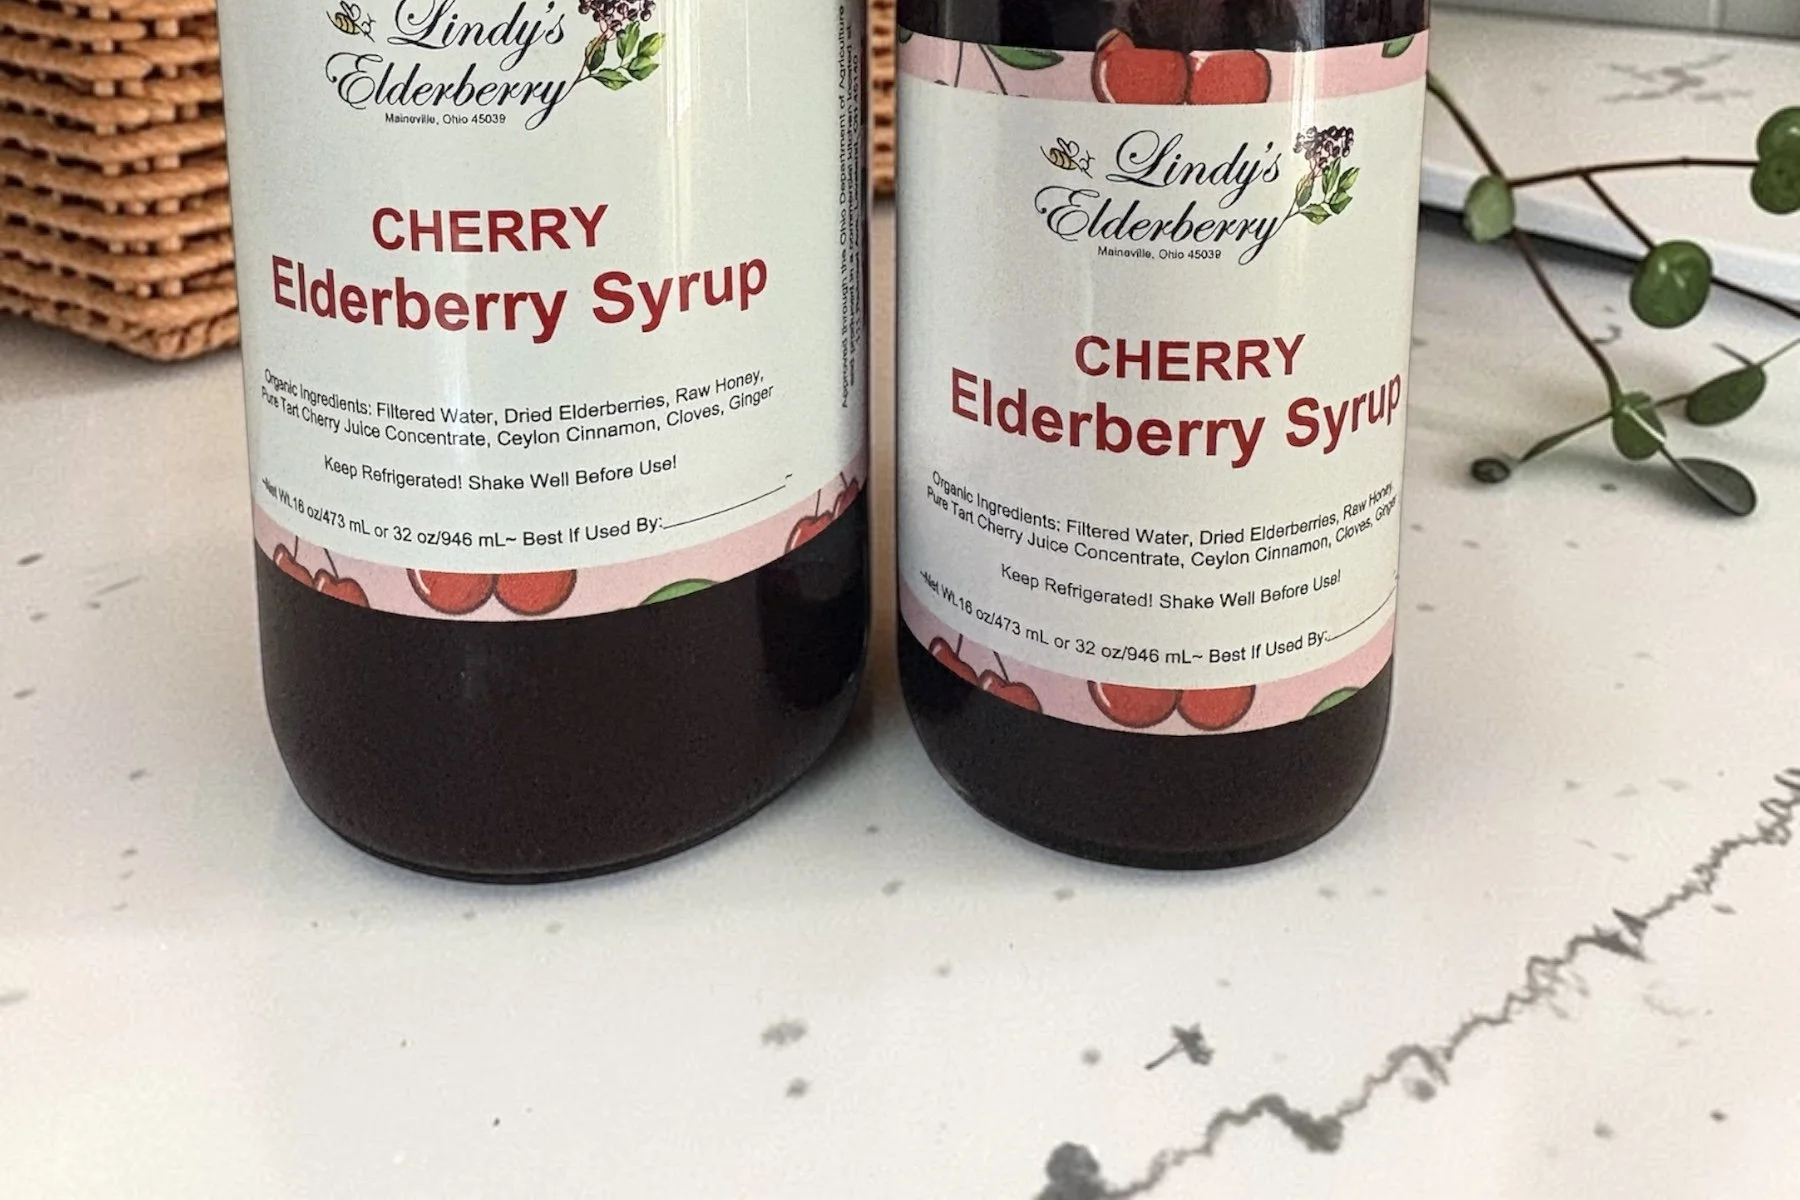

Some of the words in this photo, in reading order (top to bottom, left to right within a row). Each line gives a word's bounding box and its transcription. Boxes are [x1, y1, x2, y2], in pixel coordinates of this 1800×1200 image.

[325, 52, 573, 130] Elderberry
[443, 113, 468, 124] Ohio
[471, 113, 506, 124] 45039
[1105, 129, 1282, 209] Lindy's
[372, 204, 609, 253] CHERRY
[1035, 186, 1282, 266] Elderberry
[1159, 248, 1184, 259] Ohio
[272, 254, 568, 344] Elderberry
[593, 257, 768, 333] Syrup
[1075, 334, 1306, 381] CHERRY
[261, 385, 279, 409] Pure
[280, 397, 300, 418] Tart
[302, 406, 341, 434] Cherry
[344, 418, 381, 438] Juice
[385, 425, 491, 448] Concentrate,
[497, 429, 560, 449] Ceylon
[566, 417, 661, 443] Cinnamon,
[667, 402, 725, 427] Cloves,
[729, 385, 774, 411] Ginger
[264, 368, 298, 397] Organic
[300, 384, 372, 415] Ingredients:
[377, 401, 435, 422] Filtered
[440, 408, 498, 426] Water,
[505, 407, 552, 424] Dried
[559, 395, 670, 420] Elderberries,
[676, 385, 711, 404] Raw
[716, 369, 764, 394] Honey,
[952, 367, 1266, 469] Elderberry
[1285, 373, 1401, 455] Syrup
[324, 454, 358, 479] Keep
[362, 464, 462, 489] Refrigerated!
[469, 473, 524, 491] Shake
[530, 471, 569, 489] Well
[576, 464, 634, 485] Before
[639, 454, 677, 476] Use!
[307, 504, 346, 529] oz/473
[349, 519, 371, 535] mL
[374, 526, 389, 538] or
[393, 525, 412, 542] 32
[417, 529, 473, 547] oz/946
[522, 531, 563, 547] Best
[569, 527, 580, 543] If
[585, 520, 630, 540] Used
[927, 485, 949, 510] Pure
[951, 501, 974, 524] Tart
[977, 514, 1023, 545] Cherry
[1028, 532, 1069, 554] Juice
[1074, 542, 1184, 569] Concentrate,
[1191, 551, 1250, 570] Ceylon
[1255, 536, 1332, 563] Cinnamon,
[1335, 516, 1373, 543] Cloves,
[932, 470, 974, 503] Organic
[977, 492, 1061, 532] Ingredients:
[1066, 519, 1130, 542] Filtered
[1136, 528, 1193, 547] Water,
[1200, 529, 1245, 545] Dried
[1250, 513, 1340, 542] Elderberries,
[1343, 501, 1367, 520] Raw
[1001, 563, 1040, 591] Keep
[1045, 577, 1153, 608] Refrigerated!
[1159, 593, 1214, 609] Shake
[1219, 590, 1255, 608] Well
[1260, 584, 1309, 604] Before
[1313, 569, 1341, 592] Use!
[976, 611, 1021, 636] oz/473
[1025, 626, 1050, 645] mL
[1054, 636, 1071, 649] or
[1075, 638, 1095, 655] 32
[1101, 645, 1159, 663] oz/946
[1209, 649, 1246, 663] Best
[1251, 644, 1262, 659] If
[1266, 639, 1303, 657] Used
